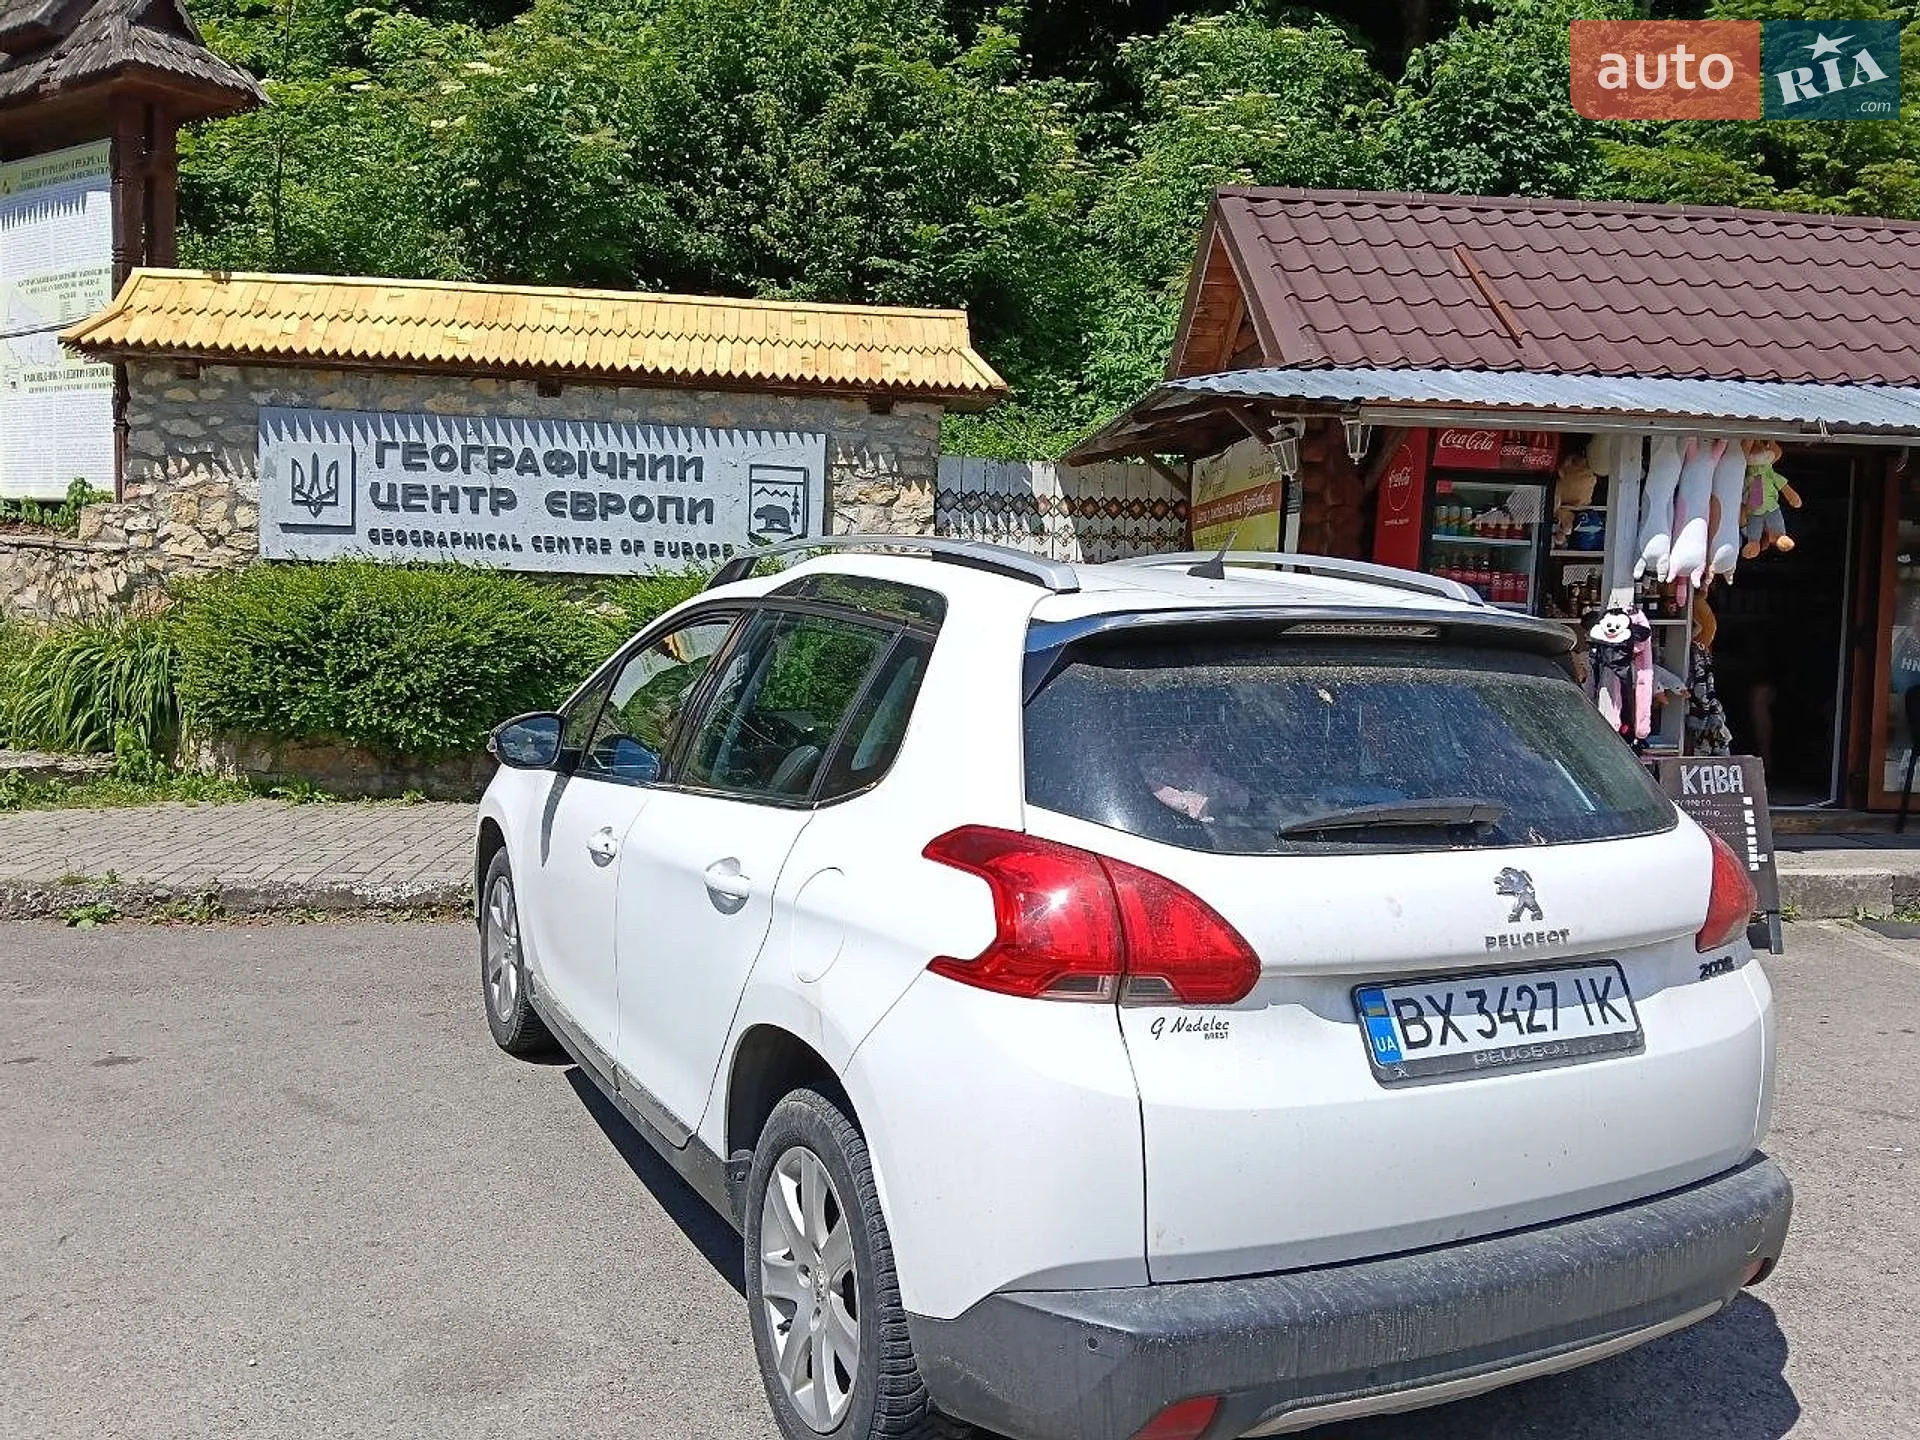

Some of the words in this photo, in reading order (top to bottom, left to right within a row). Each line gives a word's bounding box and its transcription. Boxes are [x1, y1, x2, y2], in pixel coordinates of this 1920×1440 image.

[375, 440, 705, 482] ГЕОГРАФІЧНИЙ
[369, 482, 518, 516] ЦЕНТР
[545, 490, 714, 525] ЄВРОПИ
[368, 528, 523, 552] GEOGRAPHICAL
[531, 535, 612, 555] CENTRE
[620, 538, 645, 557] OF
[1680, 765, 1744, 795] КАВА
[1485, 928, 1570, 950] PEUGEOT
[1699, 956, 1735, 981] 2008
[1169, 1015, 1230, 1033] Nedelec
[1391, 993, 1468, 1050] BX
[1465, 981, 1559, 1040] 3427
[1574, 976, 1627, 1026] IK
[1375, 1036, 1398, 1052] UA
[1473, 1043, 1569, 1066] PEUGEOT
